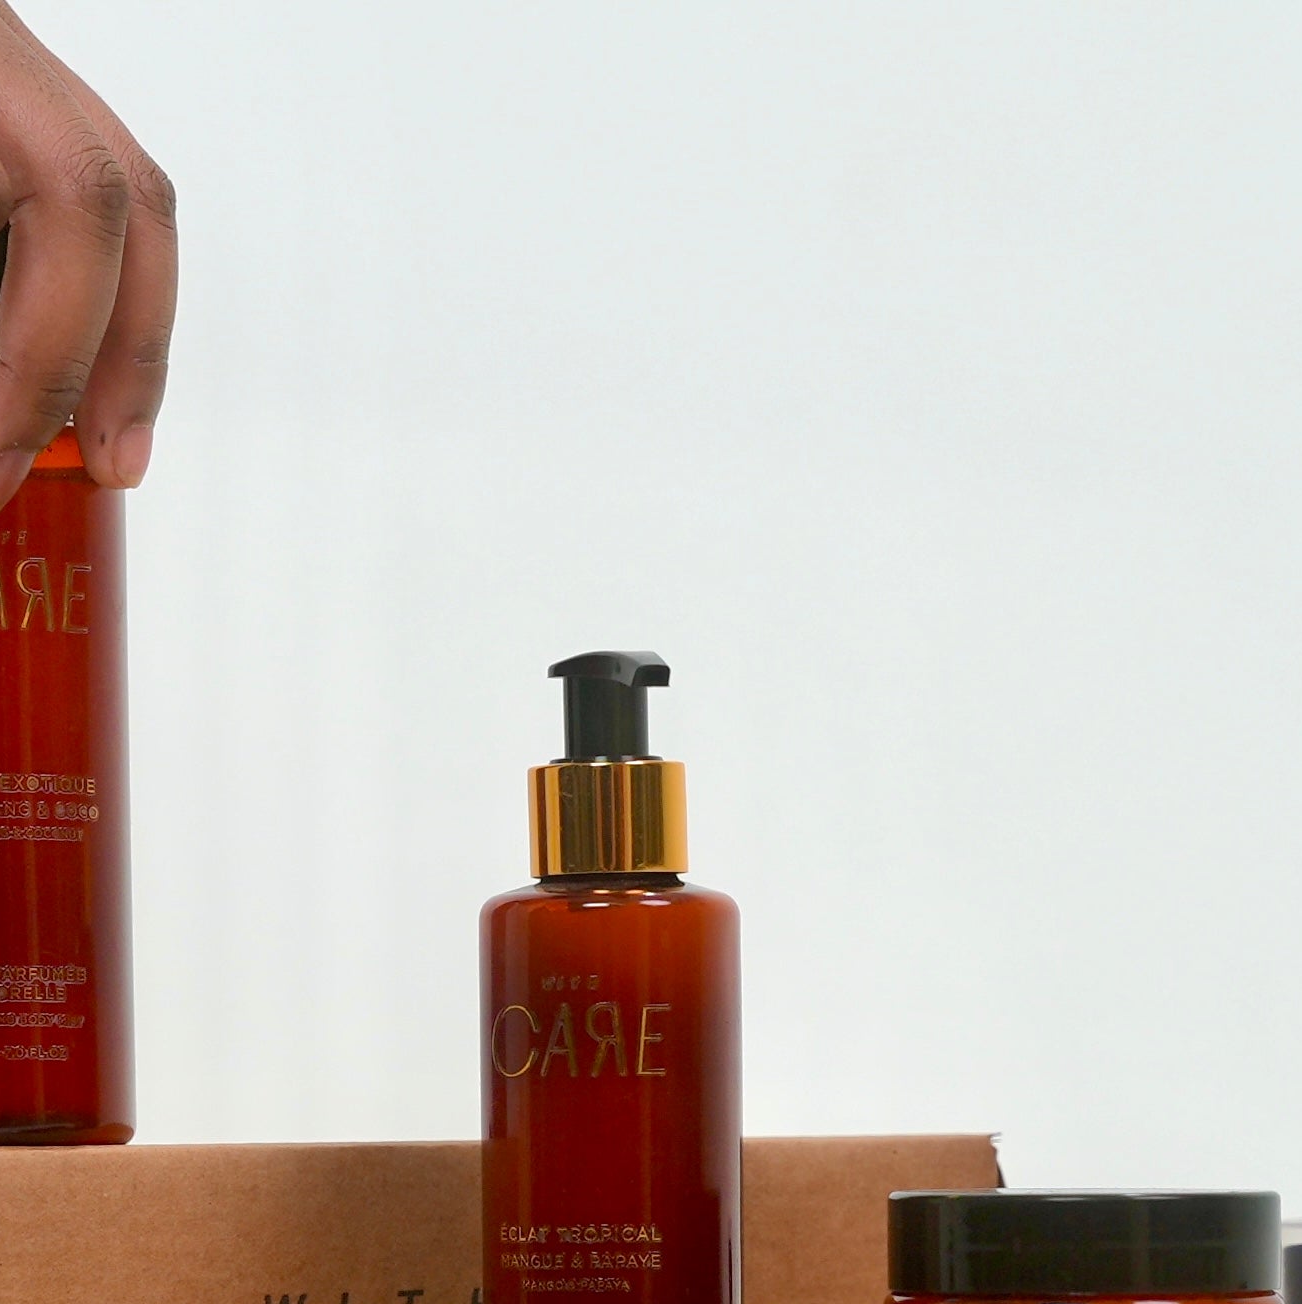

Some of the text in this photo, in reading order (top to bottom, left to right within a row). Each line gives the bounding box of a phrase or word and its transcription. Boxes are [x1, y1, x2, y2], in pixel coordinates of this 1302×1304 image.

[37, 801, 48, 820] &
[492, 1001, 672, 1078] CARE
[556, 1223, 663, 1244] TROPICAL
[500, 1250, 662, 1270] MANGUE & PAPAYE
